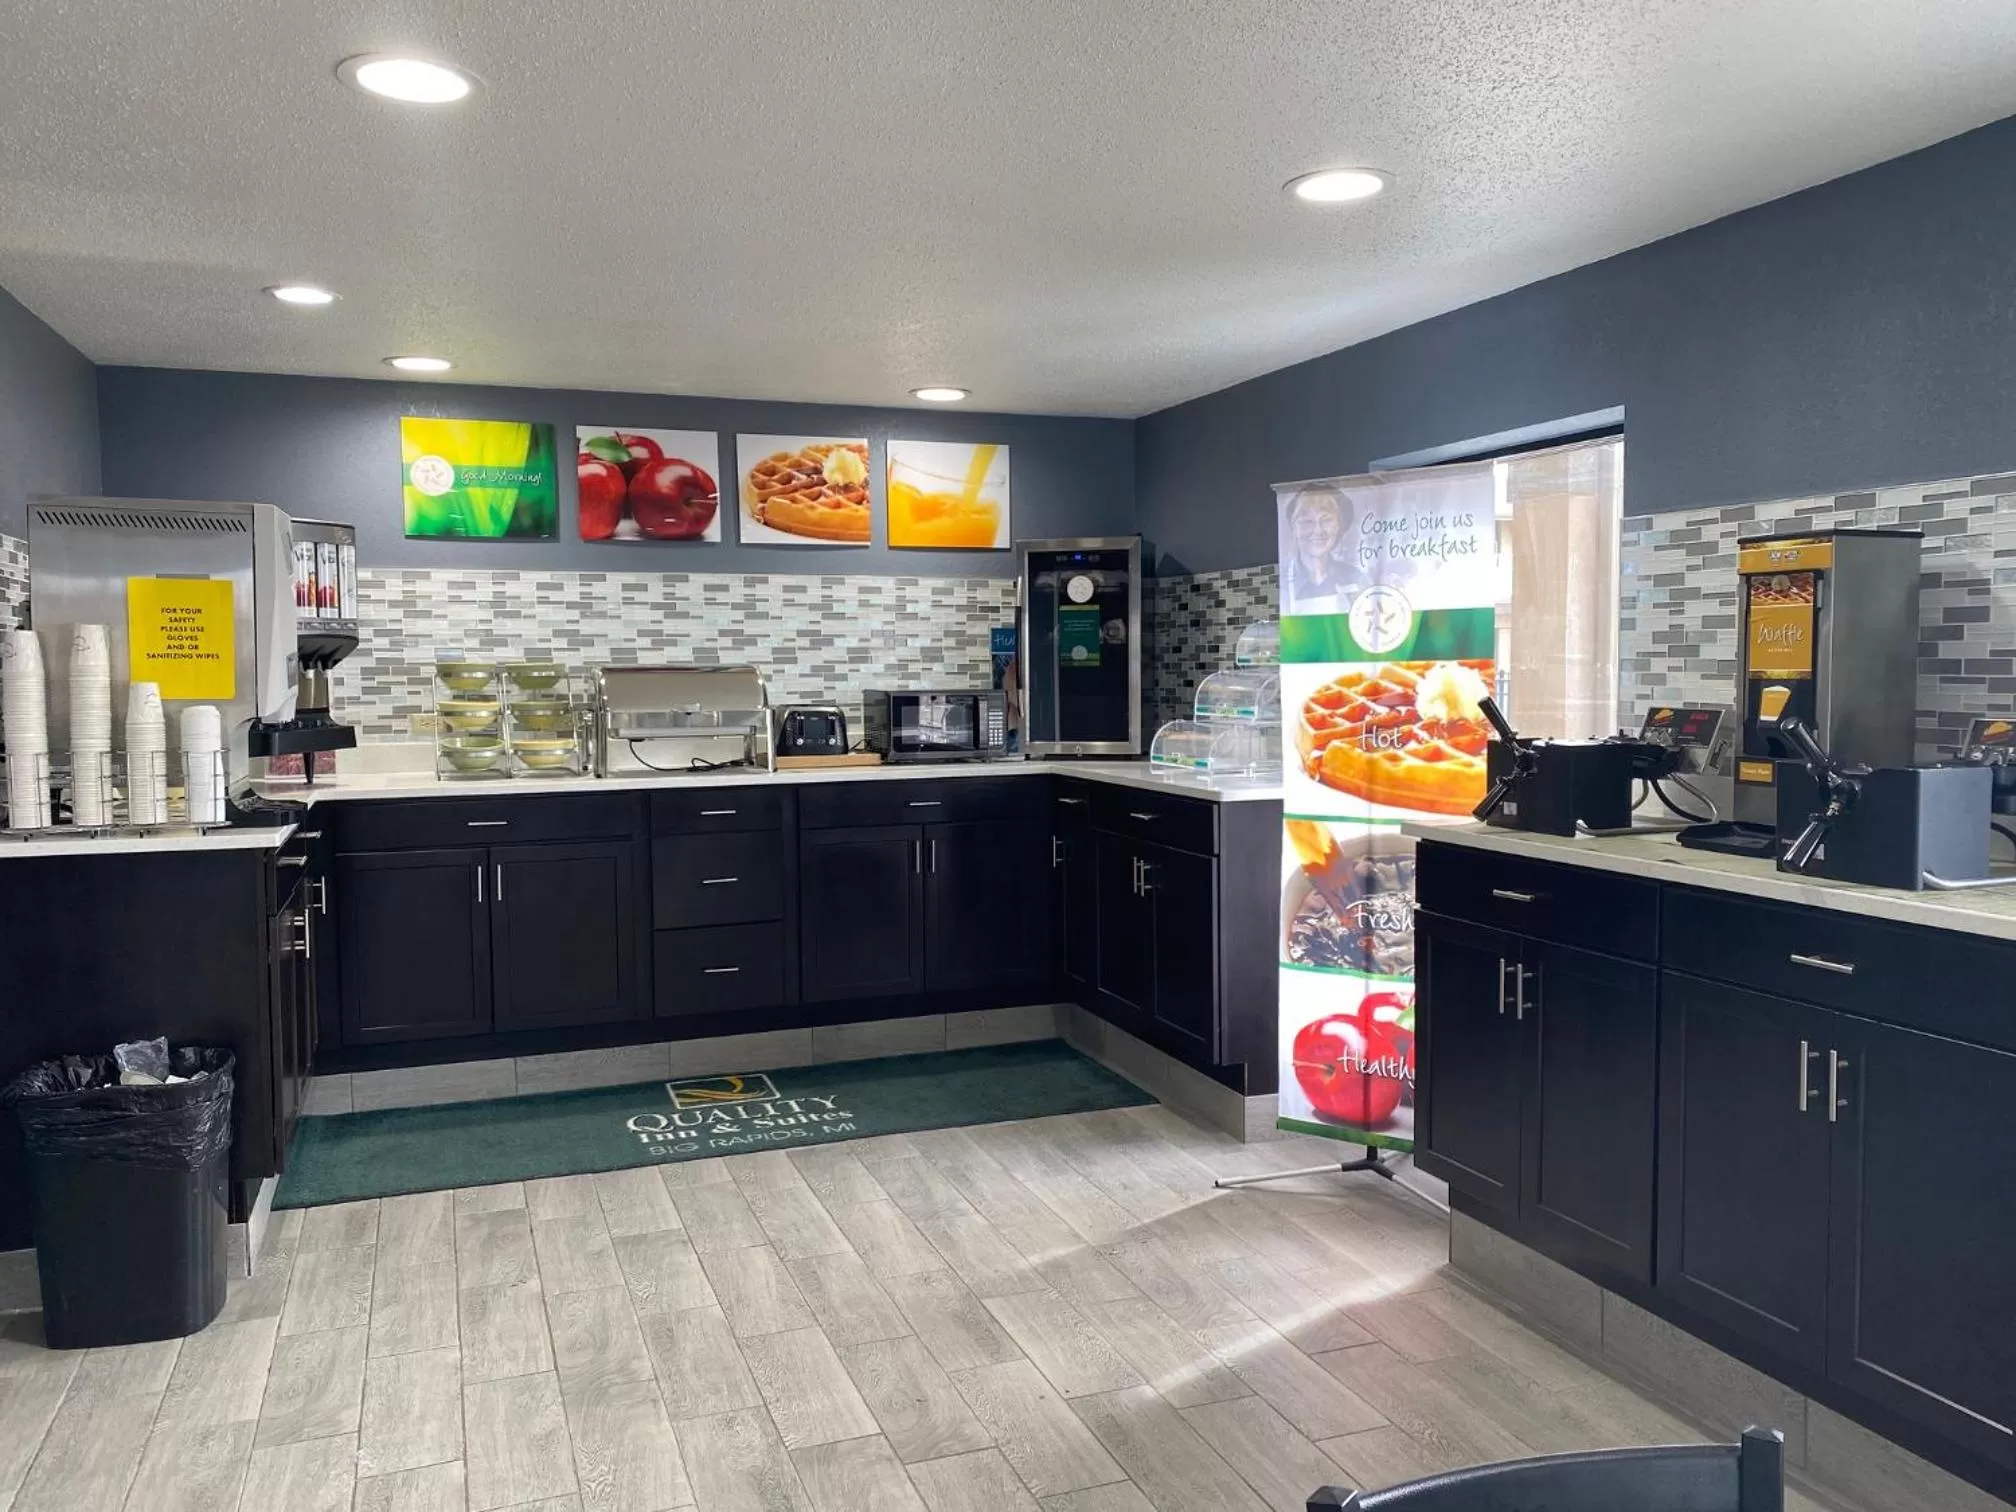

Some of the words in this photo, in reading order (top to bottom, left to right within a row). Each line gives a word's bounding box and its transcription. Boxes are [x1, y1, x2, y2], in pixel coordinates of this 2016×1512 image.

[461, 469, 487, 484] Good
[491, 471, 542, 486] Morning!
[1361, 511, 1408, 535] Come
[1411, 510, 1447, 541] join
[1452, 513, 1474, 528] us
[1358, 539, 1382, 568] for
[1389, 532, 1478, 563] breakfast
[161, 607, 177, 615] FOR
[180, 607, 202, 615] YOUR
[168, 616, 195, 624] SAFETY
[160, 625, 188, 633] PLEASE
[166, 634, 199, 642] GLOVES
[1757, 623, 1805, 646] Waffle
[146, 652, 193, 660] SANITIZING
[195, 652, 220, 660] WIPES
[166, 643, 185, 651] AND
[1357, 721, 1403, 751] Hot
[1345, 900, 1415, 932] Fresh
[626, 1095, 840, 1134] QUALITY
[638, 1130, 698, 1144] Inn
[711, 1122, 742, 1135] &
[752, 1110, 855, 1129] Suites
[650, 1142, 700, 1156] BIG
[822, 1122, 857, 1134] MI
